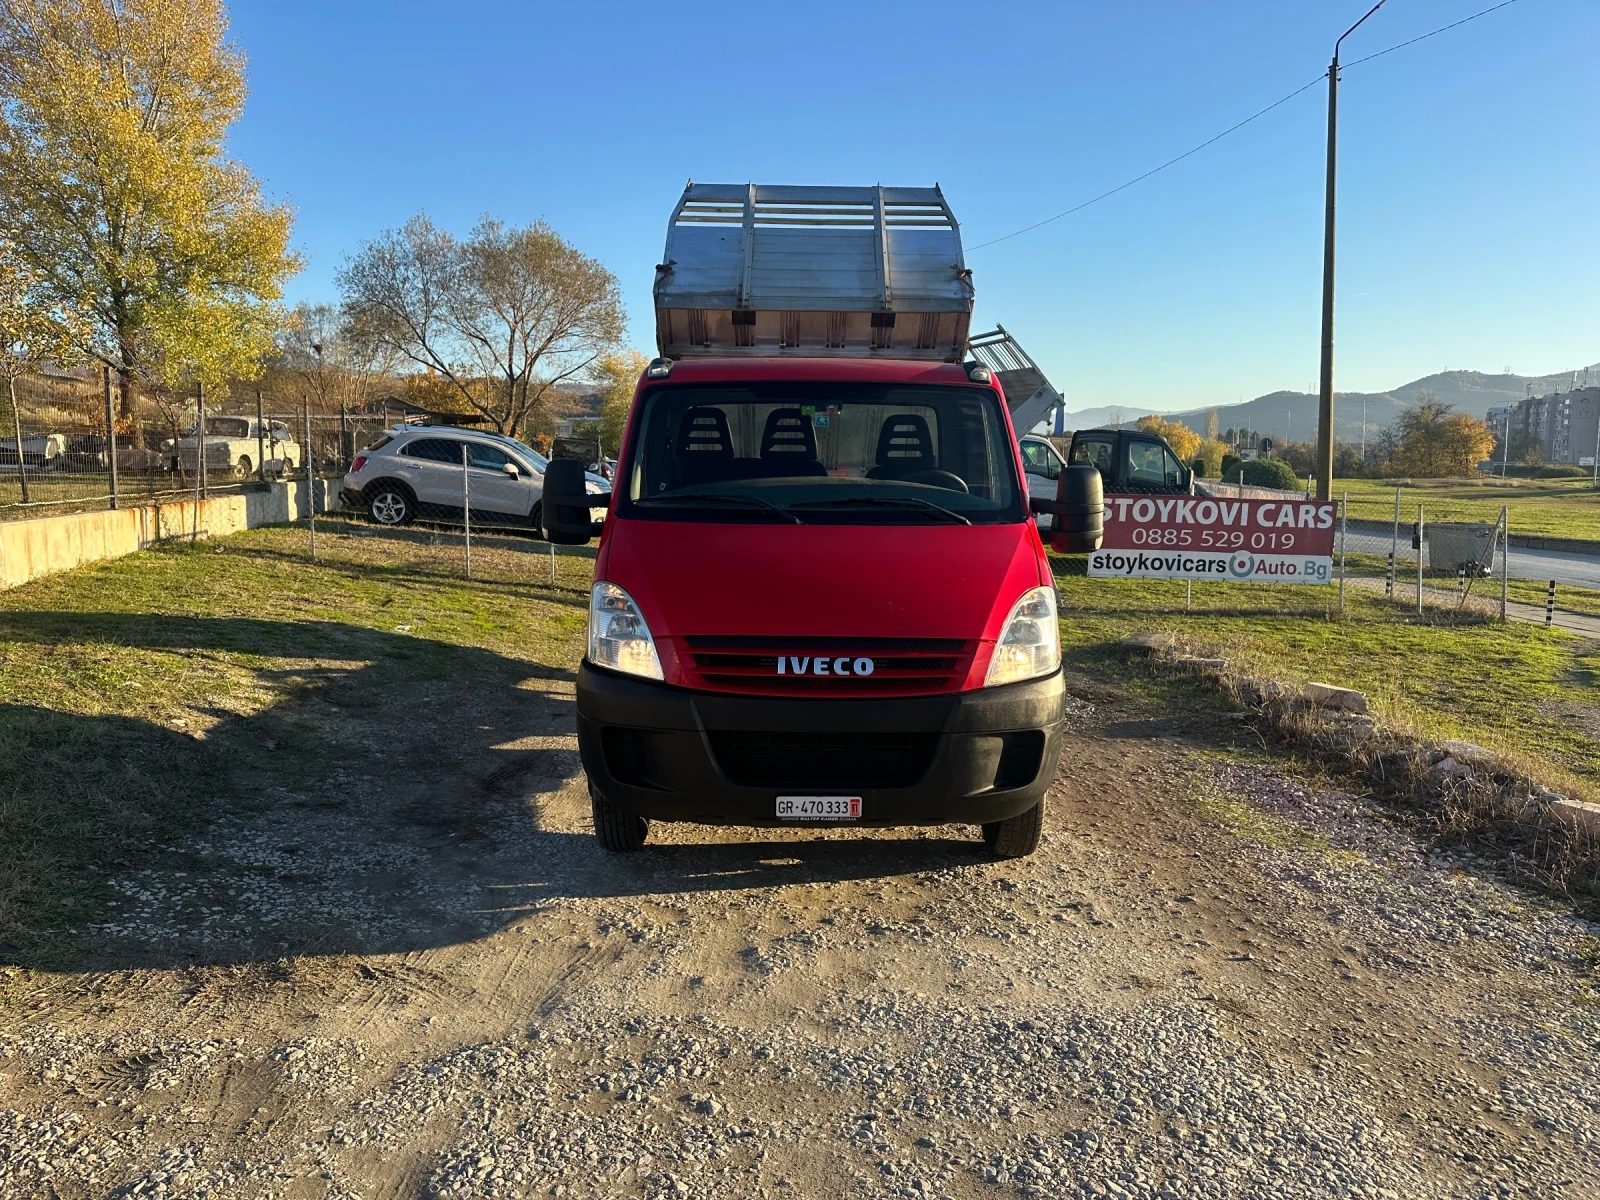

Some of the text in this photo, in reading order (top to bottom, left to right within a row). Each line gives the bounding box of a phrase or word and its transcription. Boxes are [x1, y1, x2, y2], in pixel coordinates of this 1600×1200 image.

[1103, 497, 1334, 529] STOYKOVI CARS
[1132, 527, 1295, 550] 0885 529 019
[1092, 552, 1328, 580] stoykovicars Auto.Bg
[777, 656, 875, 676] IVECO
